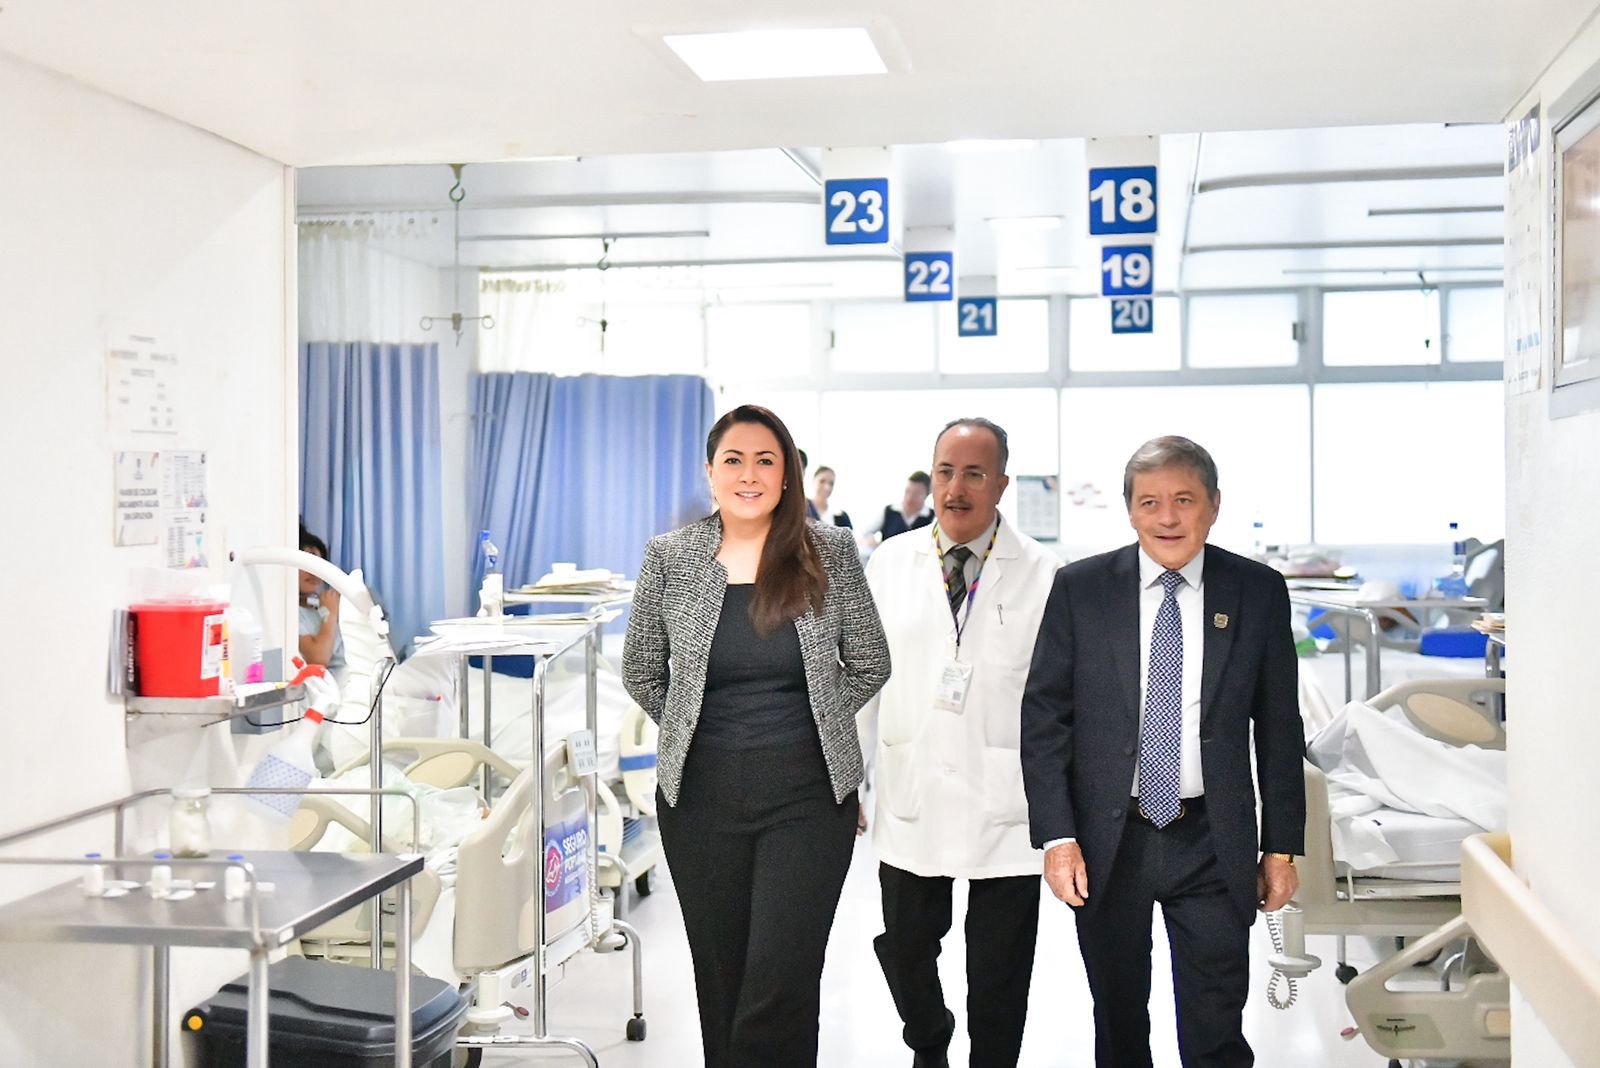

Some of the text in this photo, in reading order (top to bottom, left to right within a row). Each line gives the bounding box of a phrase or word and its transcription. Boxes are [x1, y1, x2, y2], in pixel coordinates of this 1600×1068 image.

[830, 190, 884, 233] 23
[1090, 178, 1155, 223] 18
[908, 260, 950, 294] 22
[1102, 253, 1151, 288] 19
[962, 303, 992, 330] 21
[1115, 300, 1149, 327] 20
[563, 829, 587, 857] SEGURO
